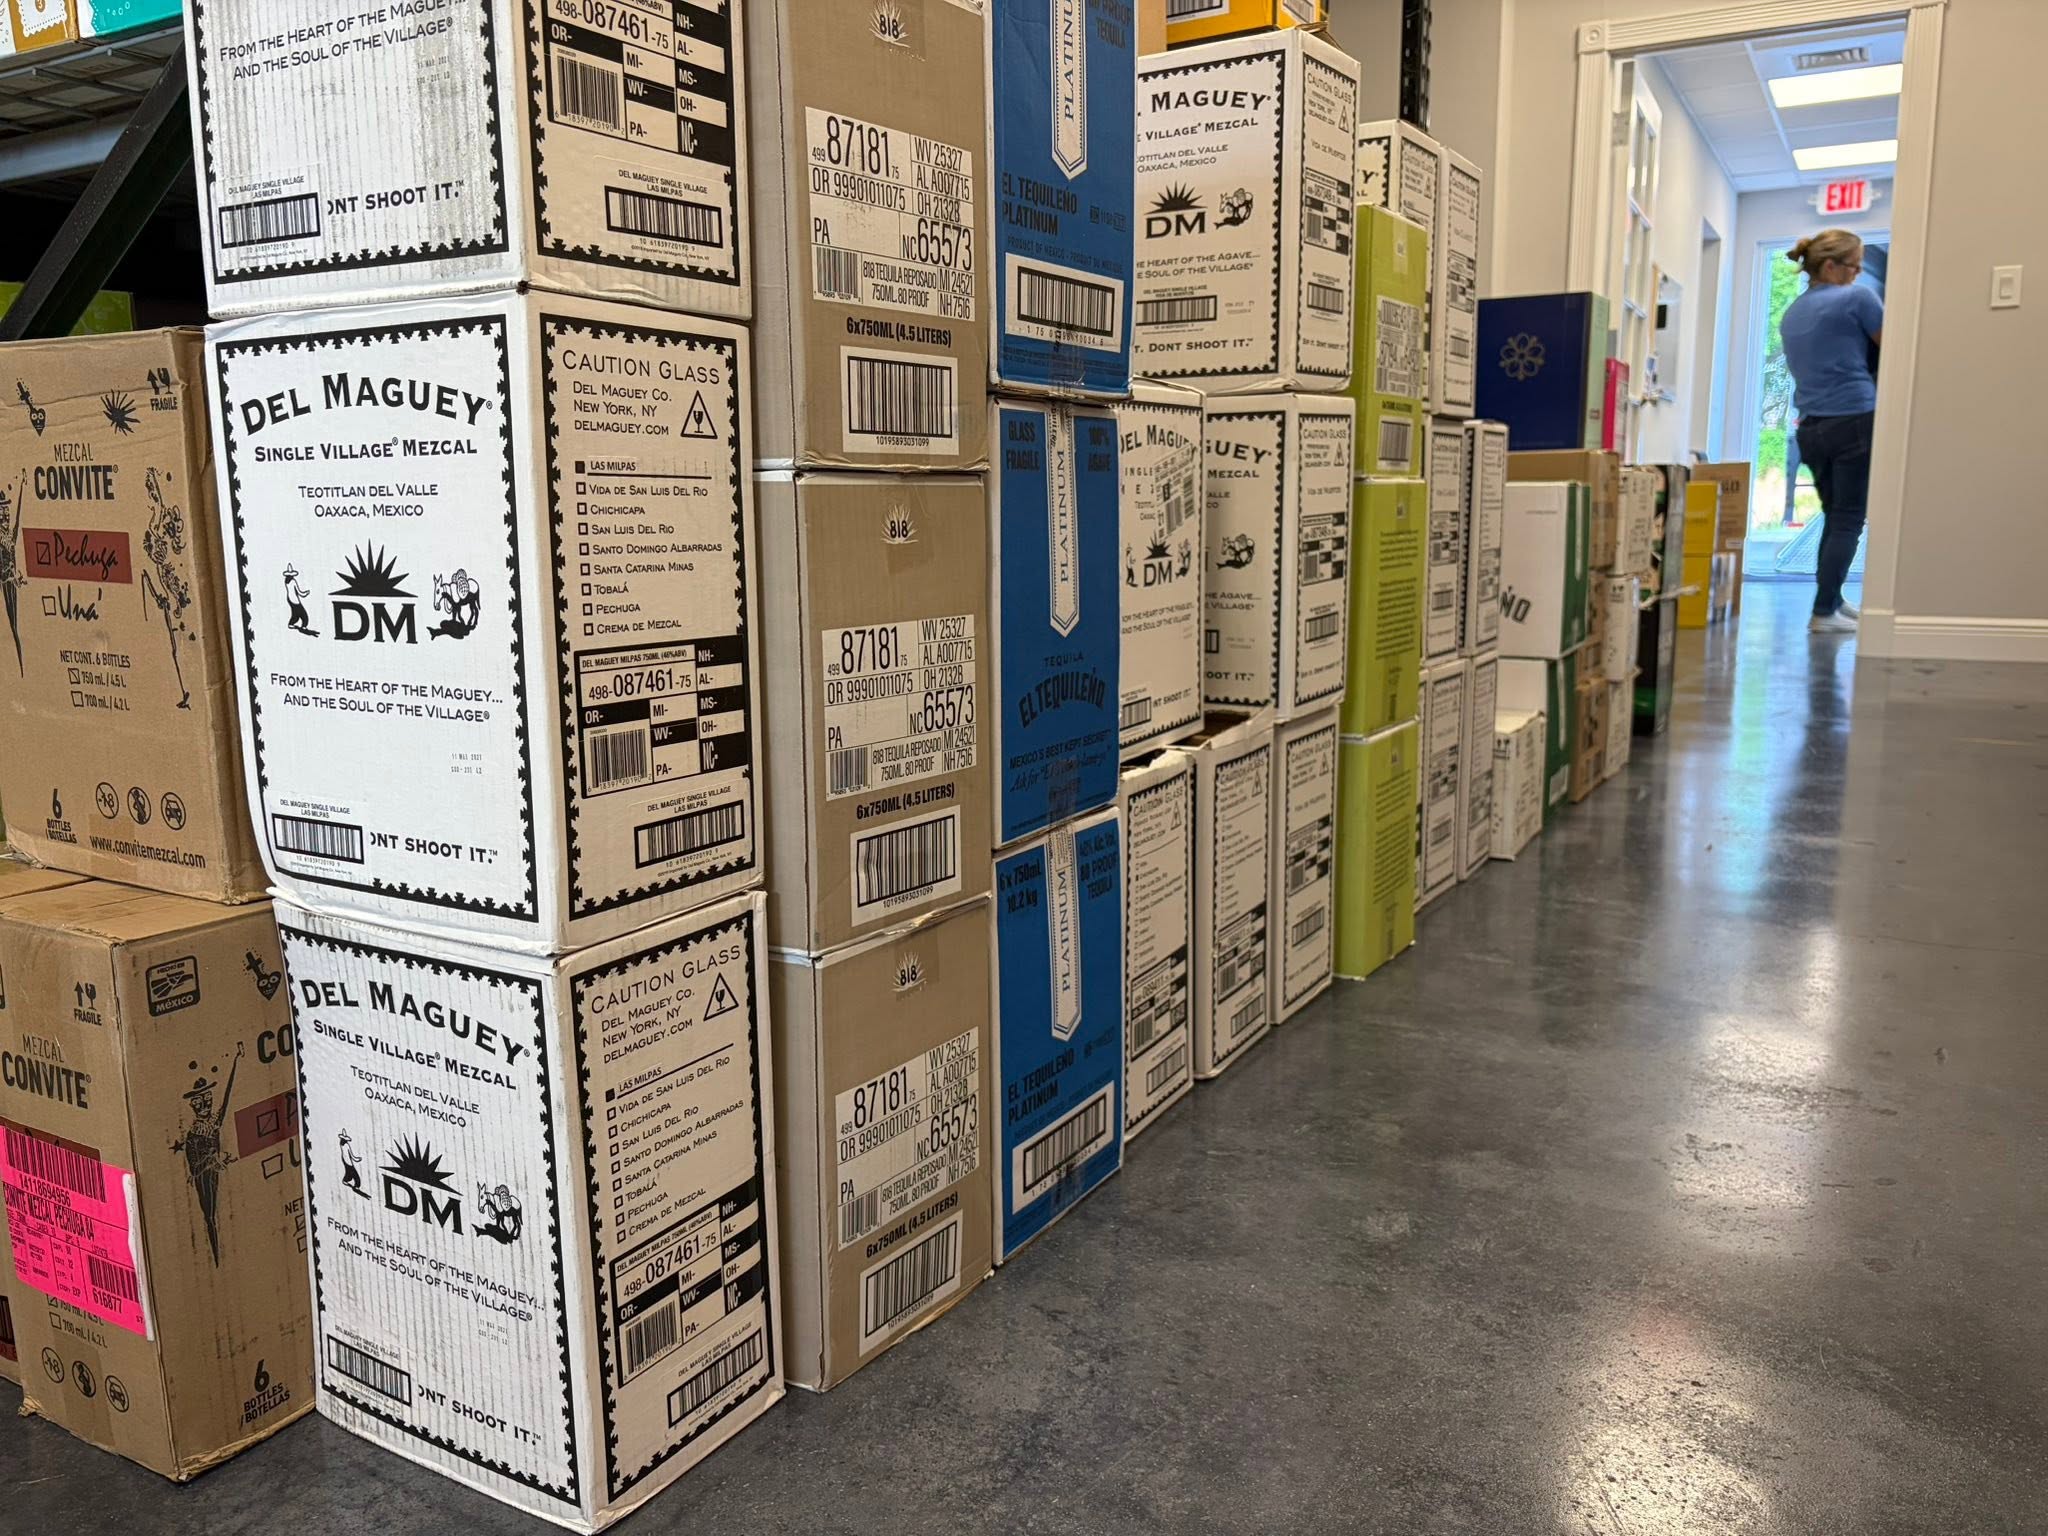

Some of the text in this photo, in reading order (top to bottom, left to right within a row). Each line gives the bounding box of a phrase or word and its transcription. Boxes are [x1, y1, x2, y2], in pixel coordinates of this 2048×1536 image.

[879, 15, 900, 39] 818
[233, 65, 260, 80] AND
[263, 59, 289, 73] THE
[291, 47, 328, 67] SOUL
[331, 42, 350, 56] OF
[353, 35, 381, 52] THE
[1204, 117, 1259, 131] MEZCAL
[812, 115, 899, 179] 499 87181 75
[915, 137, 962, 173] WV 25327
[1181, 156, 1217, 168] MEXICO
[618, 169, 708, 194] DEL MAGUEY SINGLE VILLAGE
[812, 167, 830, 194] OR
[916, 165, 929, 190] AL
[365, 187, 426, 210] SHOOT
[647, 185, 683, 197] LAS MILPAS
[1826, 181, 1865, 211] EXIT
[917, 192, 931, 216] OH
[814, 217, 830, 244] PA
[1145, 211, 1206, 239] DM
[902, 234, 917, 261] NC
[918, 218, 972, 271] 65573
[940, 270, 973, 294] MI 24521
[940, 293, 970, 319] NH 7516
[896, 324, 915, 342] (4.5
[916, 328, 951, 348] LITERS)
[1149, 342, 1182, 353] DONT
[1186, 339, 1229, 349] SHOOT
[562, 350, 720, 385] CAUTION GLASS
[573, 381, 672, 401] DEL MAGUEY CO.
[151, 397, 178, 411] FRAGILE
[240, 388, 312, 436] DEL
[573, 400, 657, 417] NEW YORK, NY
[575, 421, 669, 435] DELMAGUEY.COM
[54, 443, 93, 462] MEZCAL
[255, 446, 314, 461] SINGLE
[402, 439, 477, 456] MEZCAL
[590, 461, 636, 471] LAS MILPAS
[298, 484, 438, 498] TEOTITLAN DEL VALLE
[589, 484, 708, 497] VIDA DE SAN LUIS DEL RIO
[314, 504, 423, 518] OAXACA, MEXICO
[590, 505, 645, 515] CHICHICAPA
[1058, 450, 1069, 584] PLATINUM
[591, 525, 674, 534] SAN LUIS DEL RIO
[890, 520, 908, 538] 818
[593, 543, 722, 554] SANTO DOMINGO ALBARRADAS
[593, 562, 694, 574] SANTA CATARINA MINAS
[1143, 559, 1173, 587] DM
[594, 581, 629, 594] TOBALÁ
[596, 604, 641, 614] PECHUGA
[332, 601, 418, 644] DM
[597, 619, 682, 634] CREMA DE MEZCAL
[60, 651, 130, 668] NET CONT. 6 BOTTLES
[698, 650, 714, 662] NH-
[841, 625, 899, 674] 87181
[270, 673, 306, 688] FROM
[308, 678, 332, 690] THE
[336, 678, 378, 694] HEART
[382, 682, 398, 695] OF
[402, 684, 428, 697] THE
[699, 673, 714, 685] AL-
[284, 693, 310, 706] AND
[312, 696, 336, 708] THE
[338, 698, 374, 712] SOUL
[376, 702, 394, 714] OF
[396, 704, 422, 716] THE
[653, 704, 668, 717] MI-
[701, 697, 717, 709] MS-
[923, 685, 974, 732] 65573
[585, 710, 604, 724] OR-
[702, 721, 717, 732] OH-
[702, 742, 718, 770] NC-
[656, 765, 672, 777] PA-
[52, 789, 62, 819] 6
[47, 819, 71, 831] BOTTLES
[90, 836, 205, 868] www.convitemezcal.com
[405, 838, 462, 858] SHOOT
[1058, 871, 1070, 992] PLATINUM
[592, 945, 741, 1014] CAUTION GLASS
[901, 965, 917, 986] 818
[300, 980, 359, 1008] DEL
[74, 1008, 102, 1026] FRAGILE
[22, 1034, 64, 1062] MEZCAL
